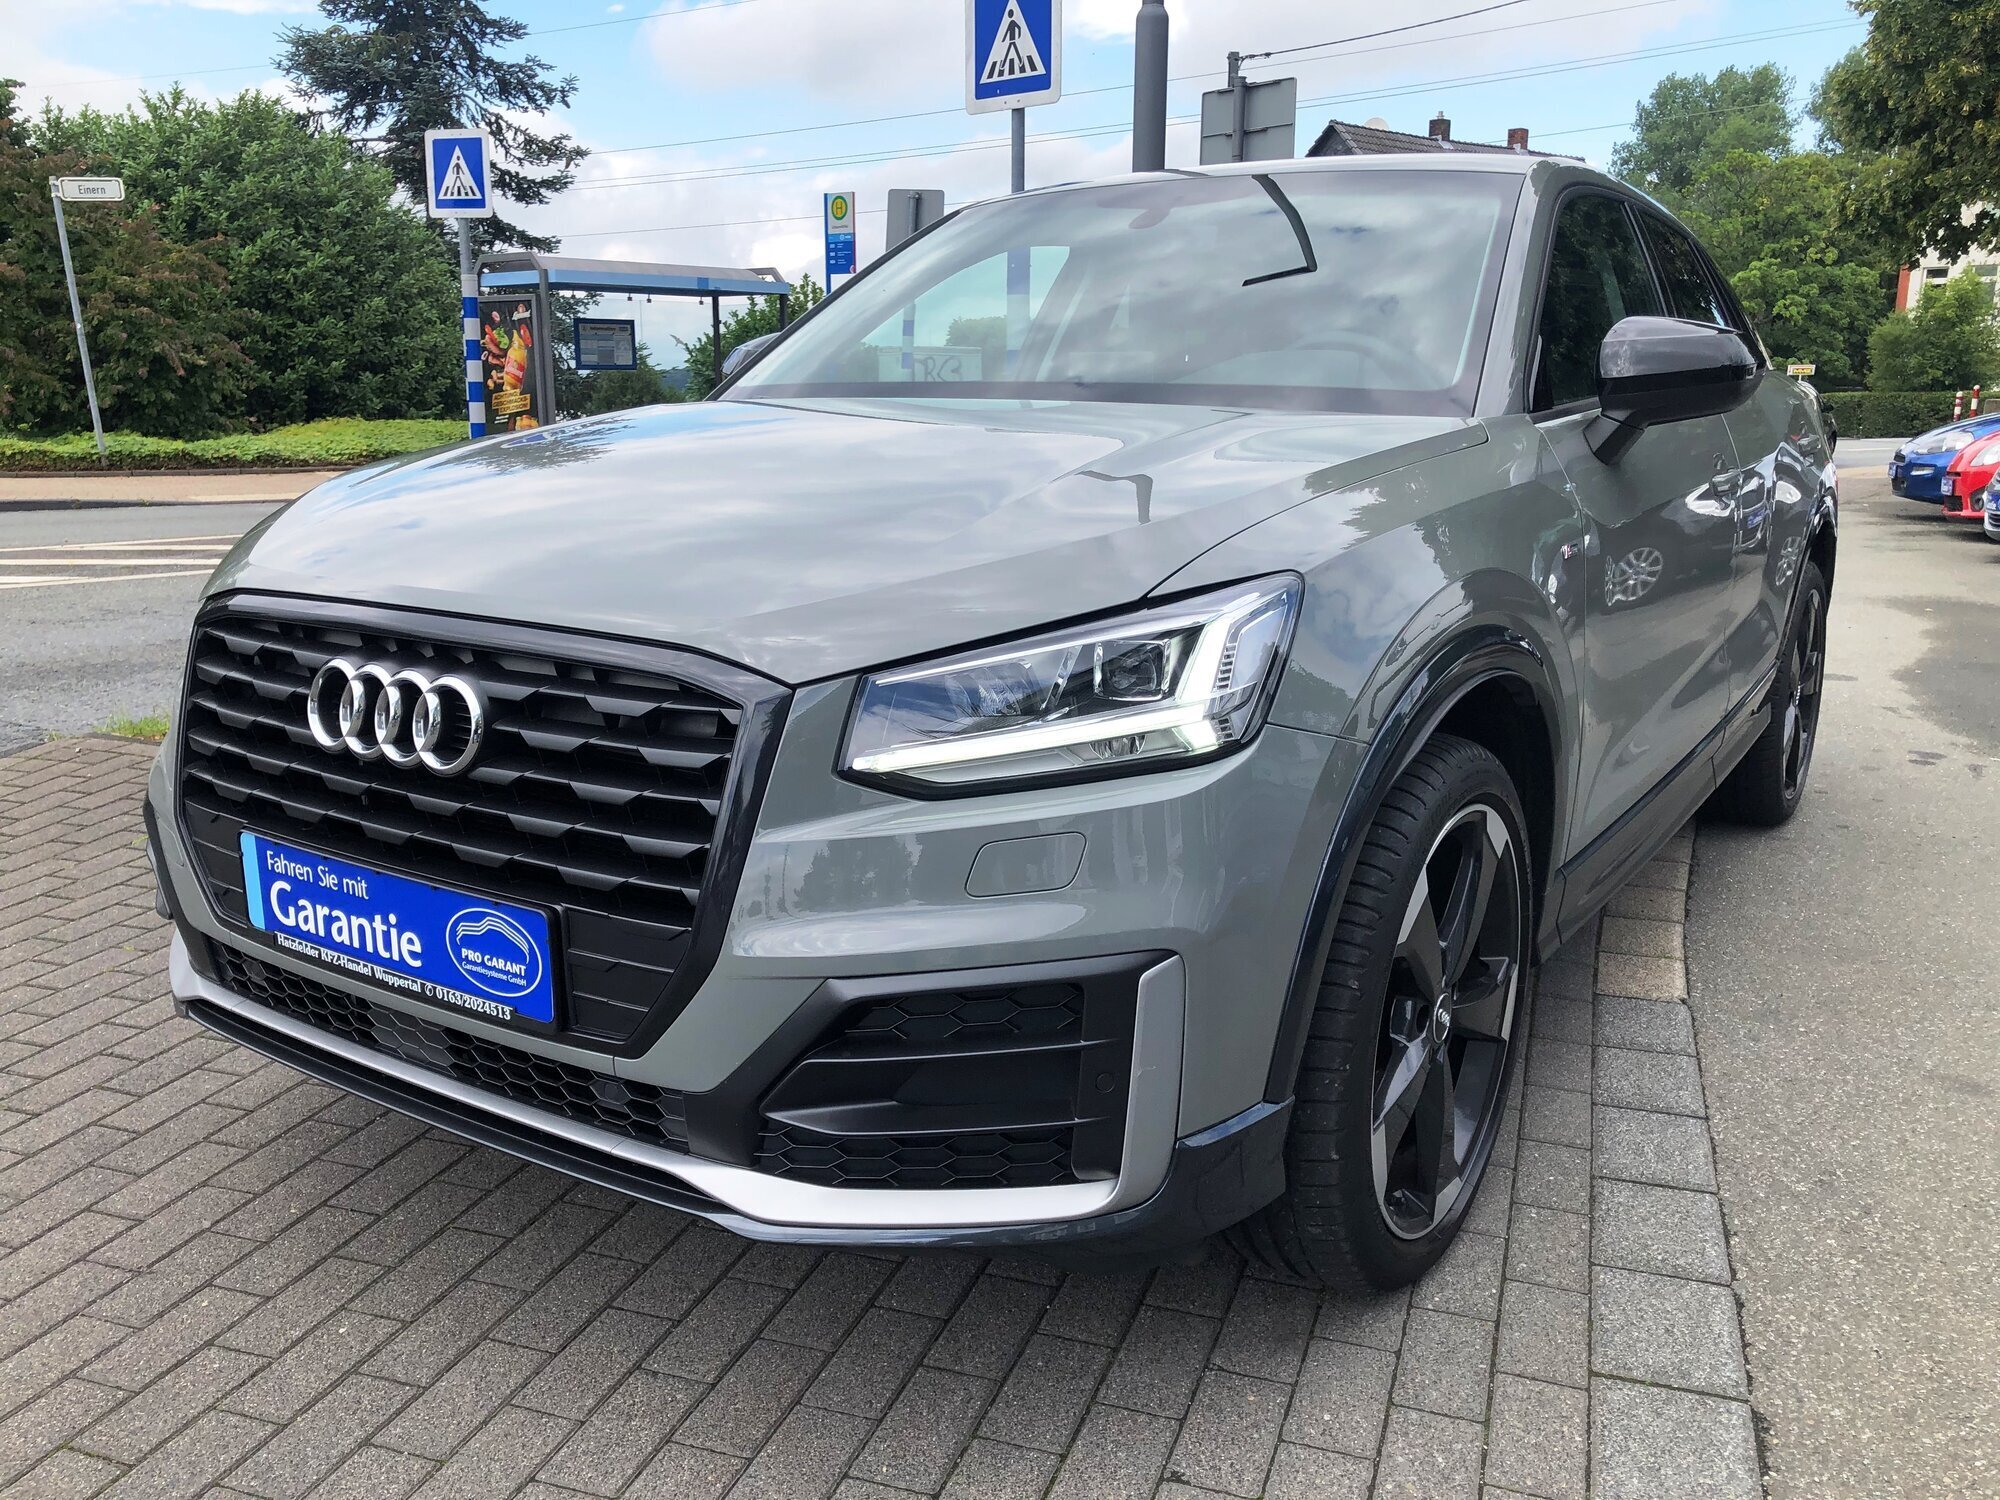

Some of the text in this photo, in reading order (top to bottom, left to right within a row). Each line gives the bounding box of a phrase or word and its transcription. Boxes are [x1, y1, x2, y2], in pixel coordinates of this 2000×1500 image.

[78, 184, 106, 195] Einern
[835, 201, 843, 216] H
[266, 850, 369, 900] Fahren Sie mit
[270, 880, 422, 968] Garantie
[276, 932, 512, 1021] Hatzfelder KFZ-Handel Wuppertal 0163/2024513
[461, 947, 526, 977] PRO GARANT
[461, 961, 527, 987] Garantiesysteme GmbH
